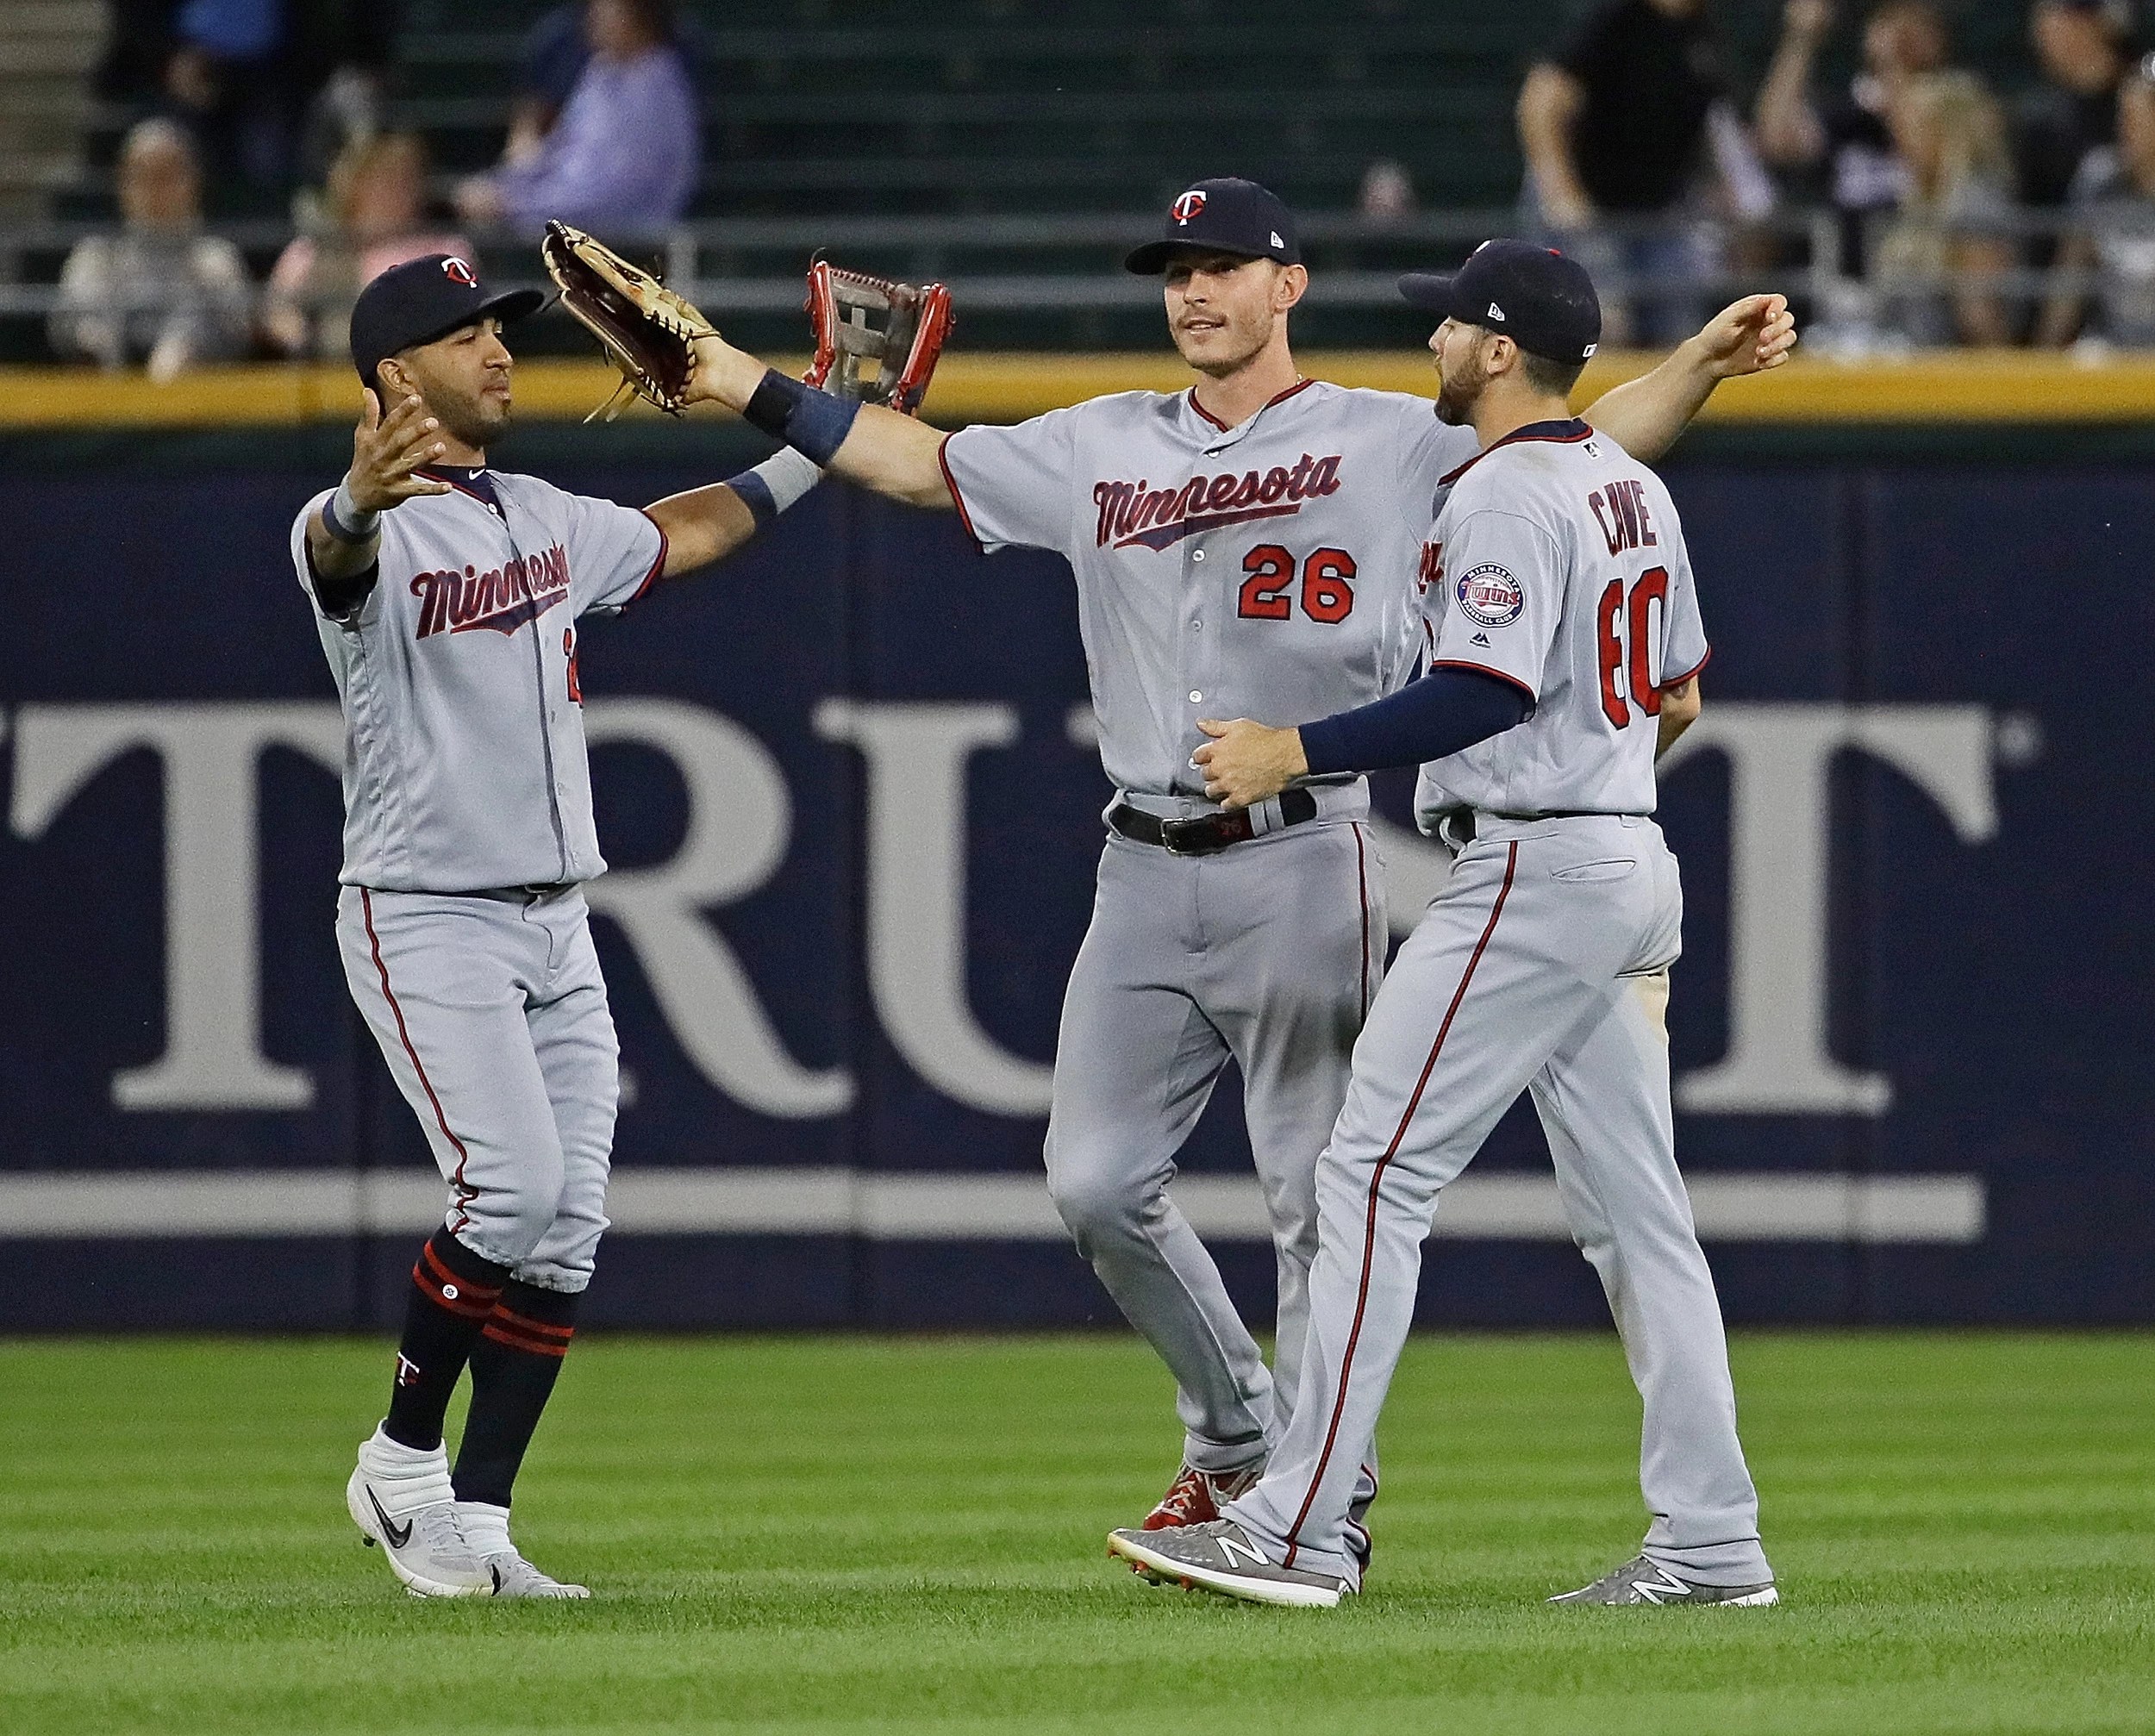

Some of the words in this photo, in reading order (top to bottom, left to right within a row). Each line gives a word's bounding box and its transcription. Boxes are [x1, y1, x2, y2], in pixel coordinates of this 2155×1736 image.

[1094, 453, 1342, 550] Minnesota
[1589, 479, 1658, 558] CAVE
[409, 540, 571, 640] Minnes
[1237, 544, 1358, 625] 26
[1467, 565, 1521, 593] MINNESOTA
[1597, 565, 1669, 731] 60
[9, 702, 1995, 1119] TRUT
